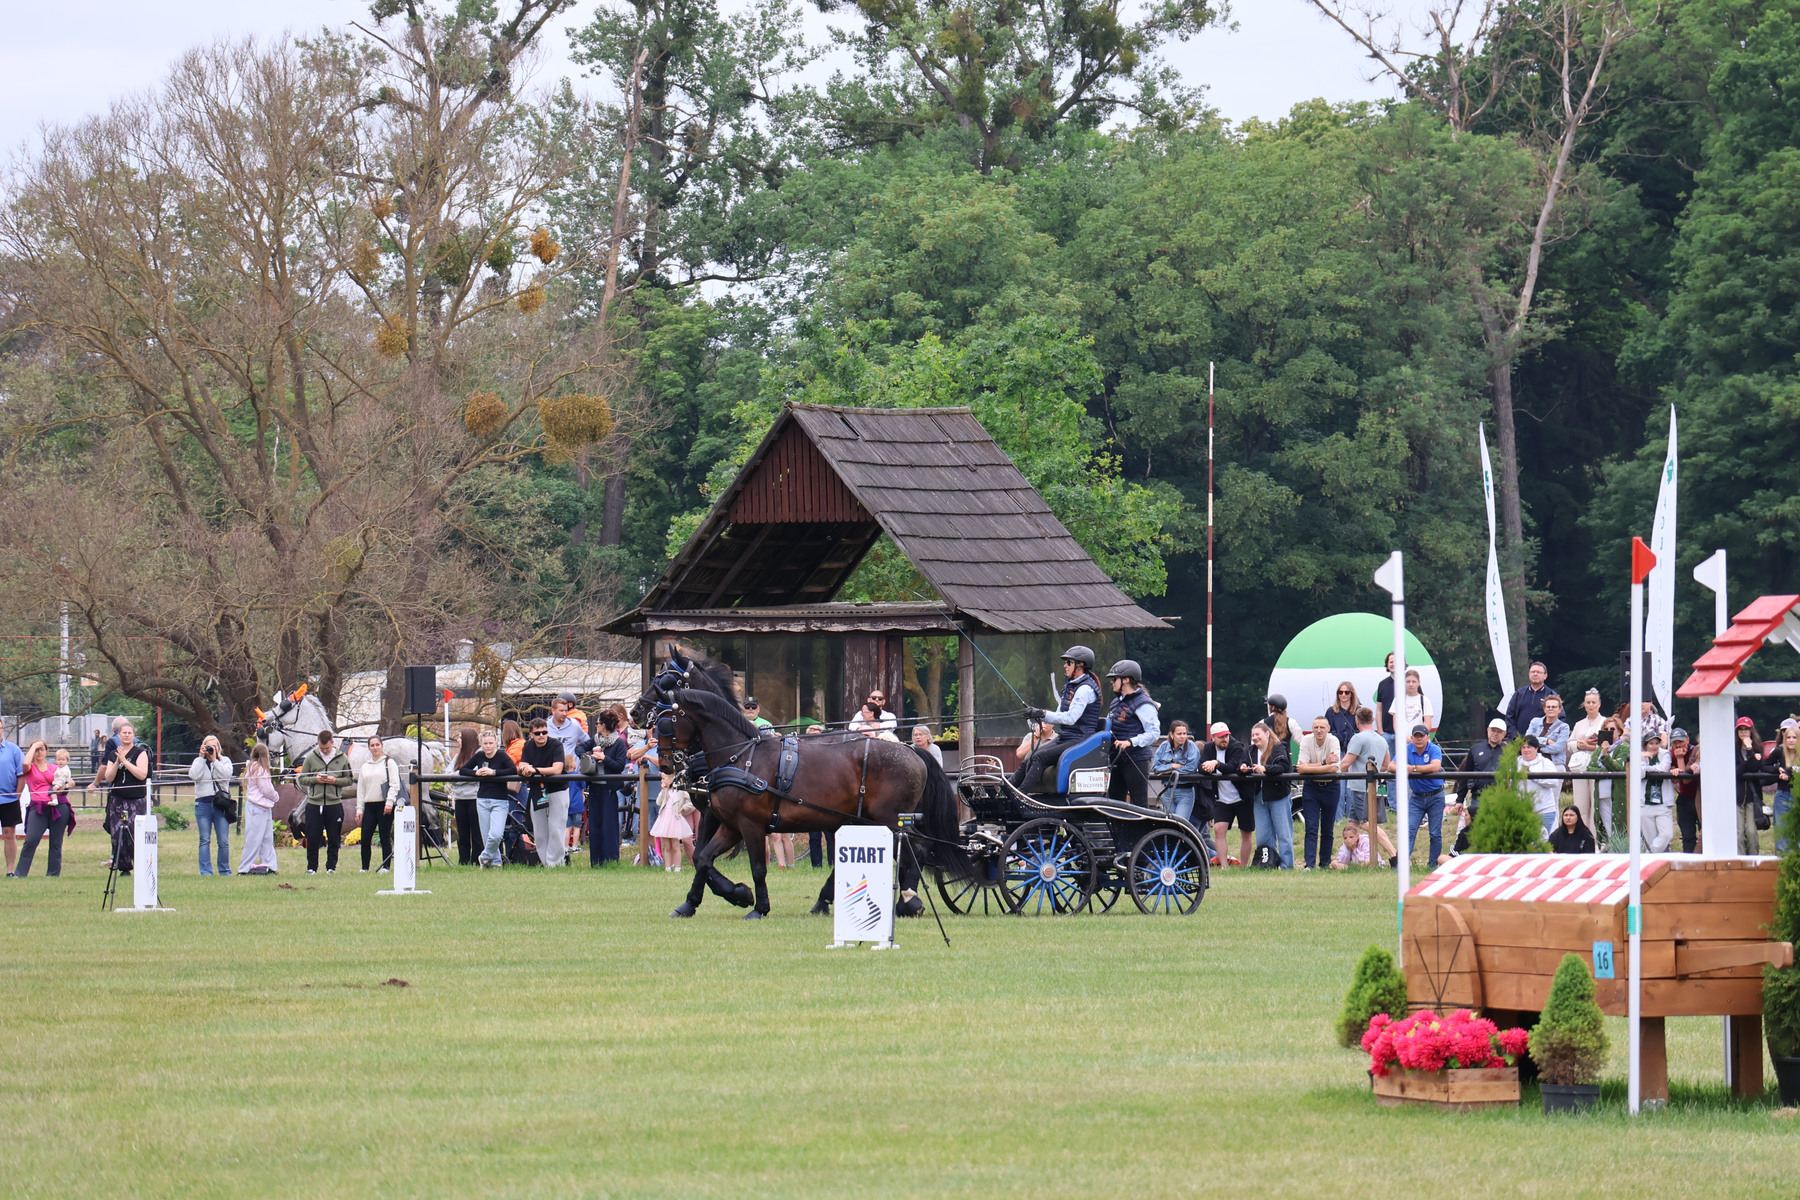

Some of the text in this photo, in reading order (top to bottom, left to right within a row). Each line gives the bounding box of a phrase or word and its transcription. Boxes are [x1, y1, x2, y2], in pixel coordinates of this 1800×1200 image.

[144, 831, 157, 845] FINISH
[838, 845, 886, 864] START
[1597, 951, 1609, 970] 16
